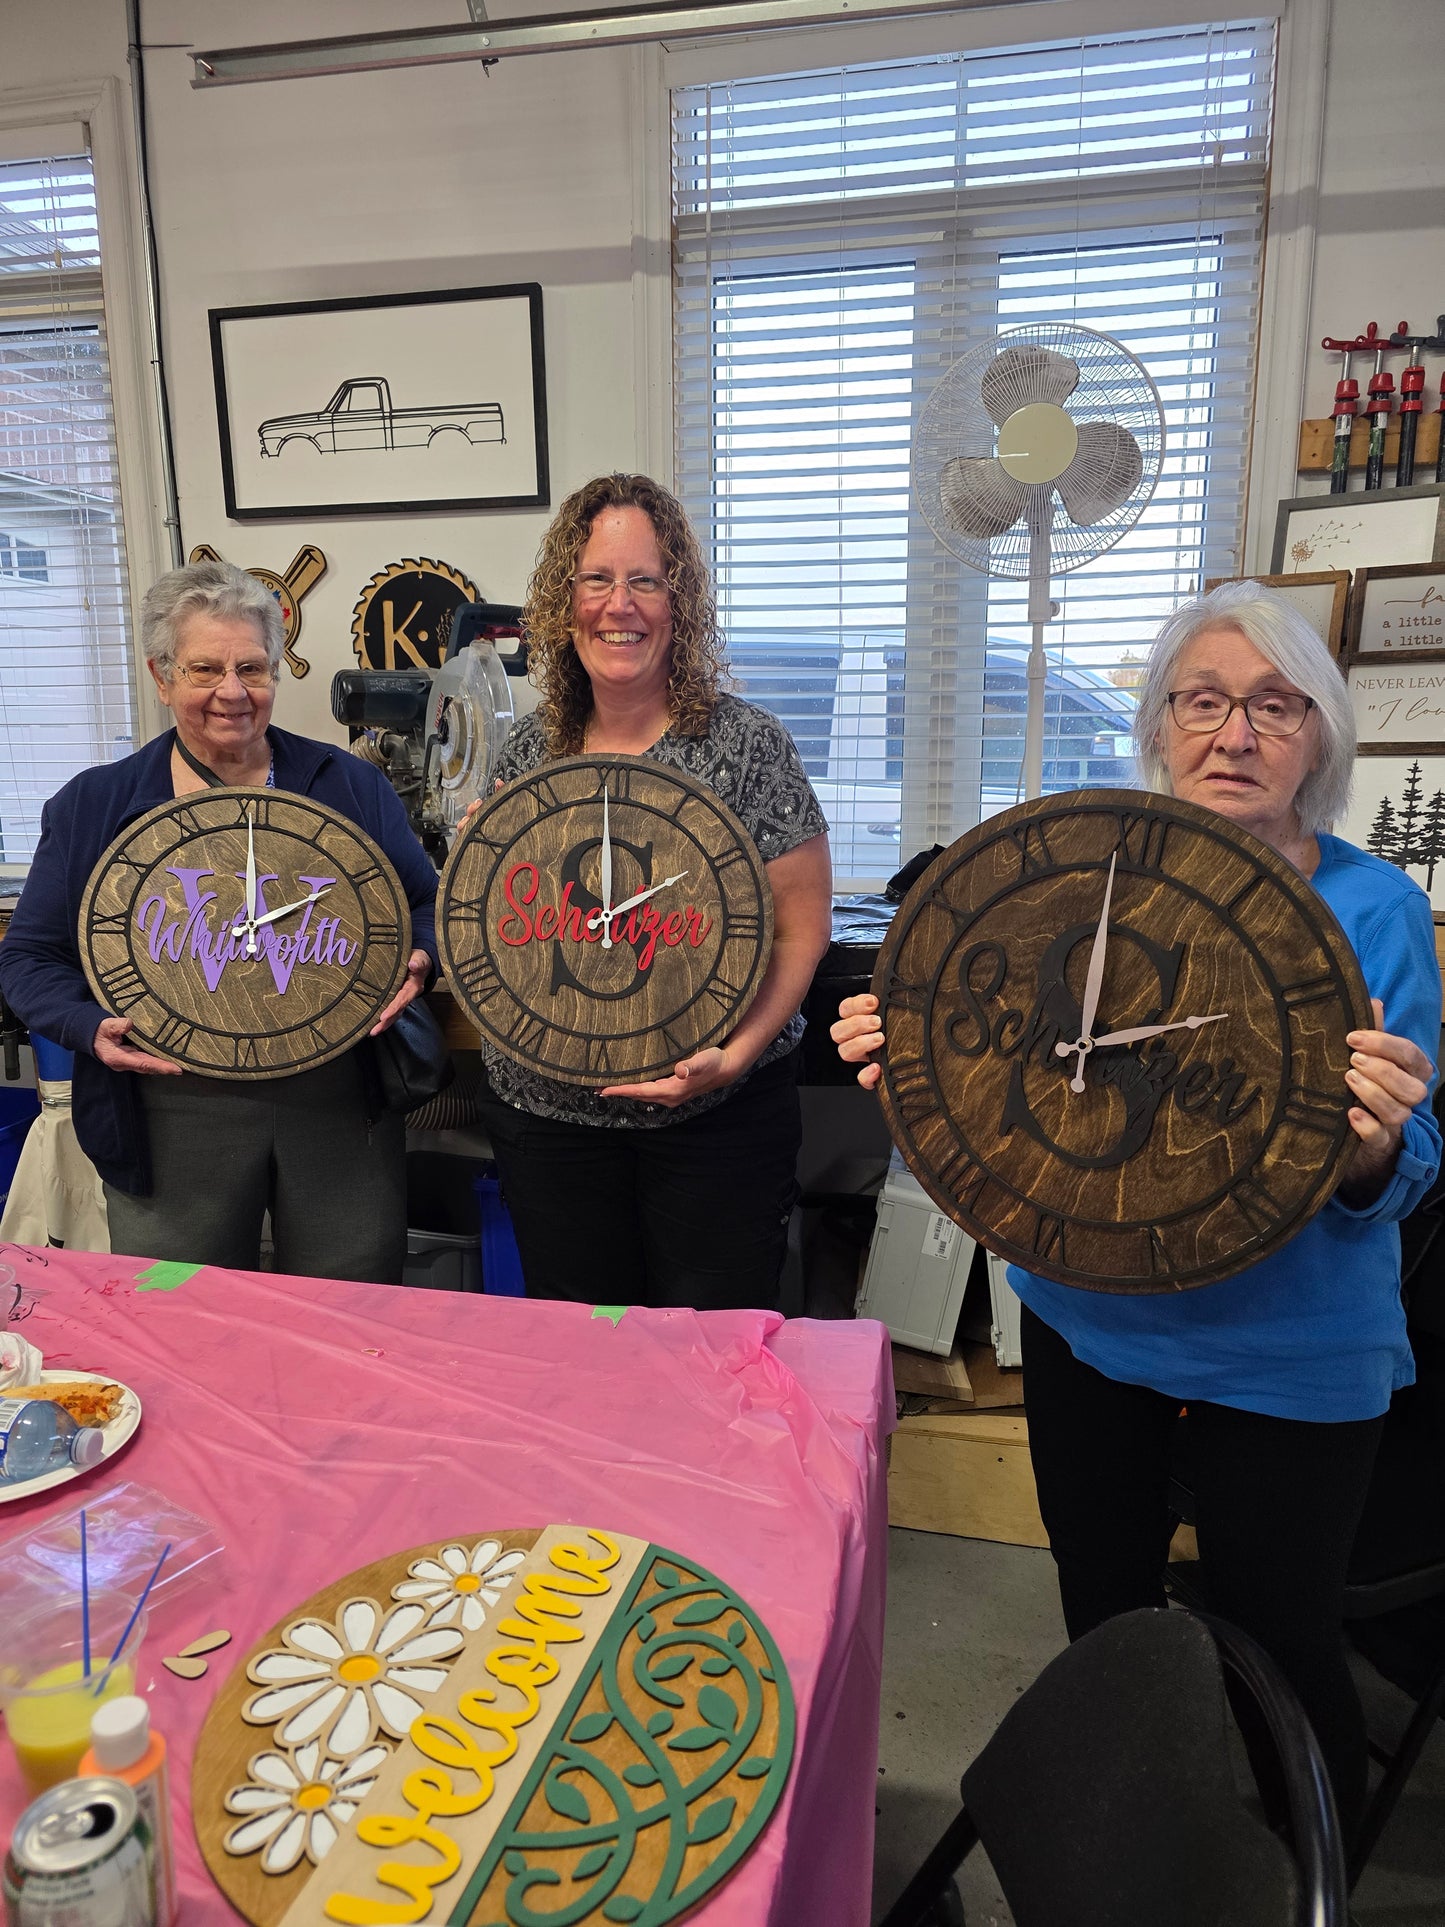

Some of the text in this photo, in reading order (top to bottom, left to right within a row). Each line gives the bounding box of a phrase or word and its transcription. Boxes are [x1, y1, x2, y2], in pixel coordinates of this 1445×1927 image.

[1382, 615, 1442, 629] a little
[1383, 634, 1443, 647] a little
[1355, 677, 1405, 691] NEVER
[548, 836, 654, 1001] S
[323, 1529, 622, 1926] welcome
